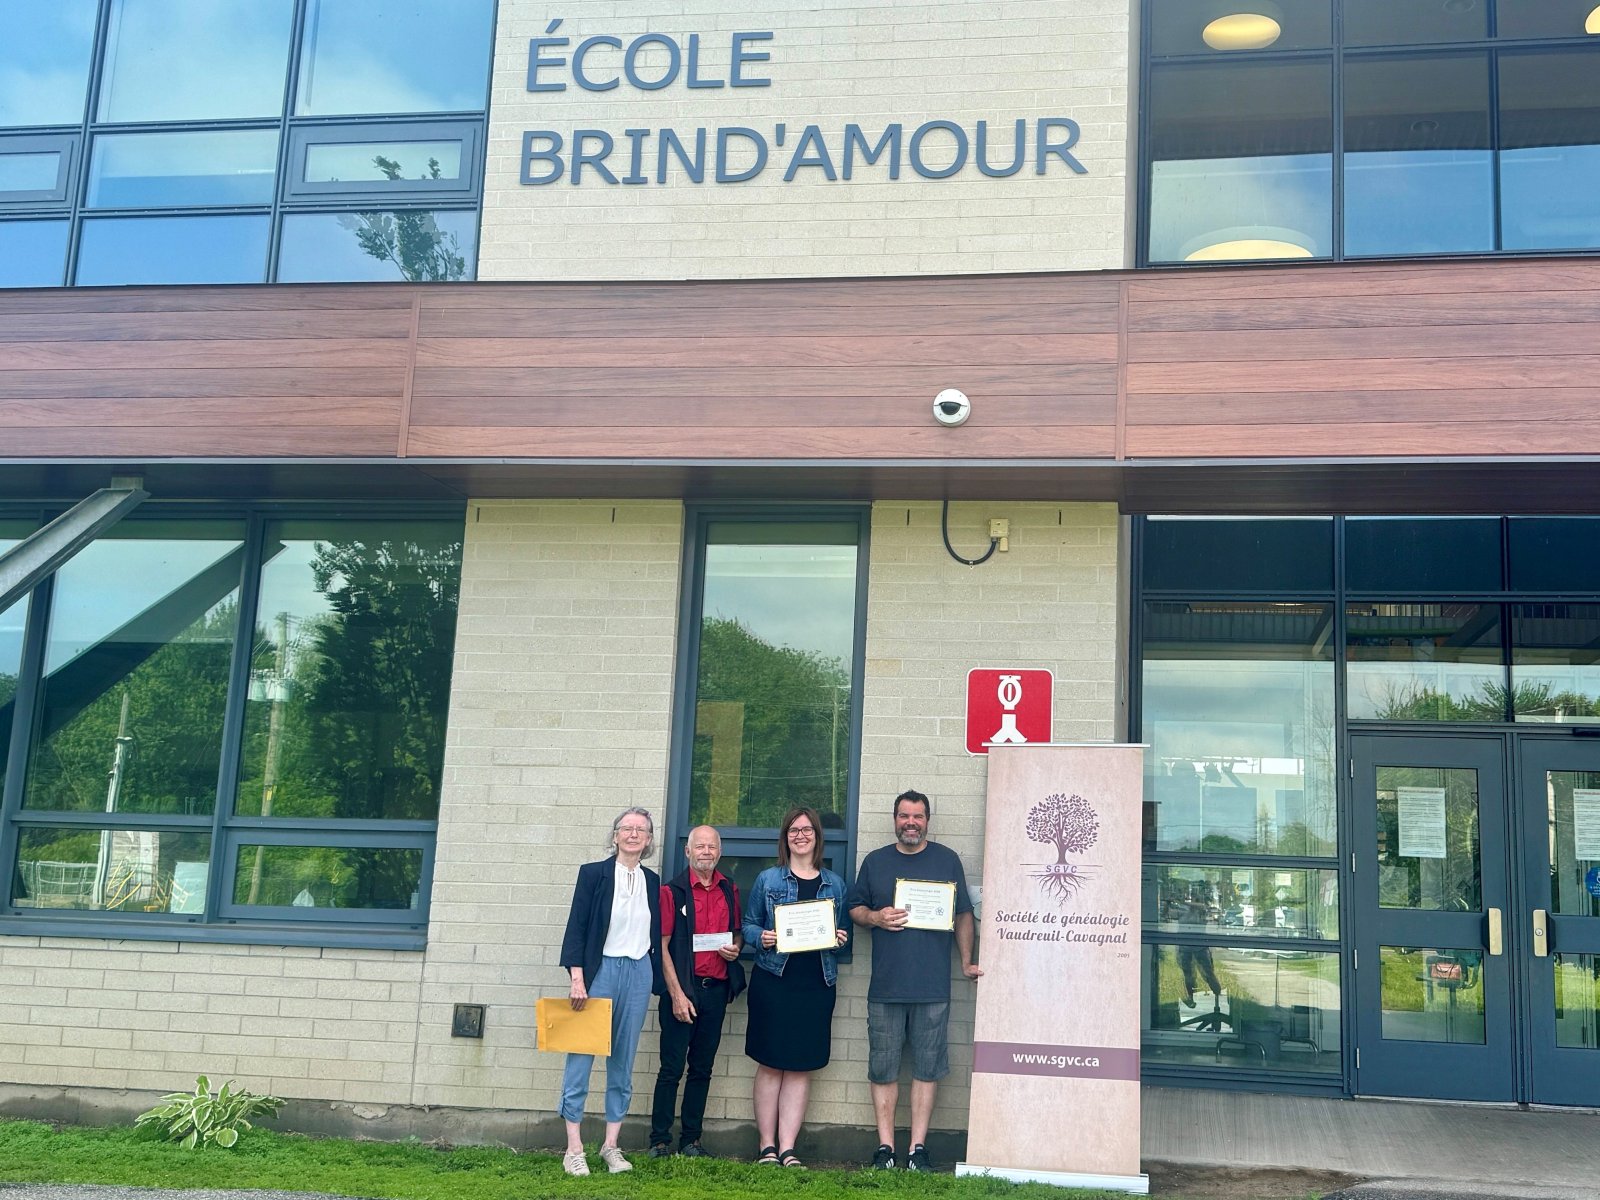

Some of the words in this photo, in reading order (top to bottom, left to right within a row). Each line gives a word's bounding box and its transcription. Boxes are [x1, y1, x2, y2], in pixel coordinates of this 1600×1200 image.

[526, 19, 774, 93] ÉCOLE
[519, 118, 1089, 186] BRIND'AMOUR
[1045, 865, 1078, 874] SGVC
[995, 910, 1040, 923] Société
[1042, 912, 1057, 924] de
[1060, 912, 1130, 929] généalogie
[996, 927, 1128, 947] Vaudreuil-Cavagnal
[1012, 1053, 1100, 1069] www.sgvc.ca
